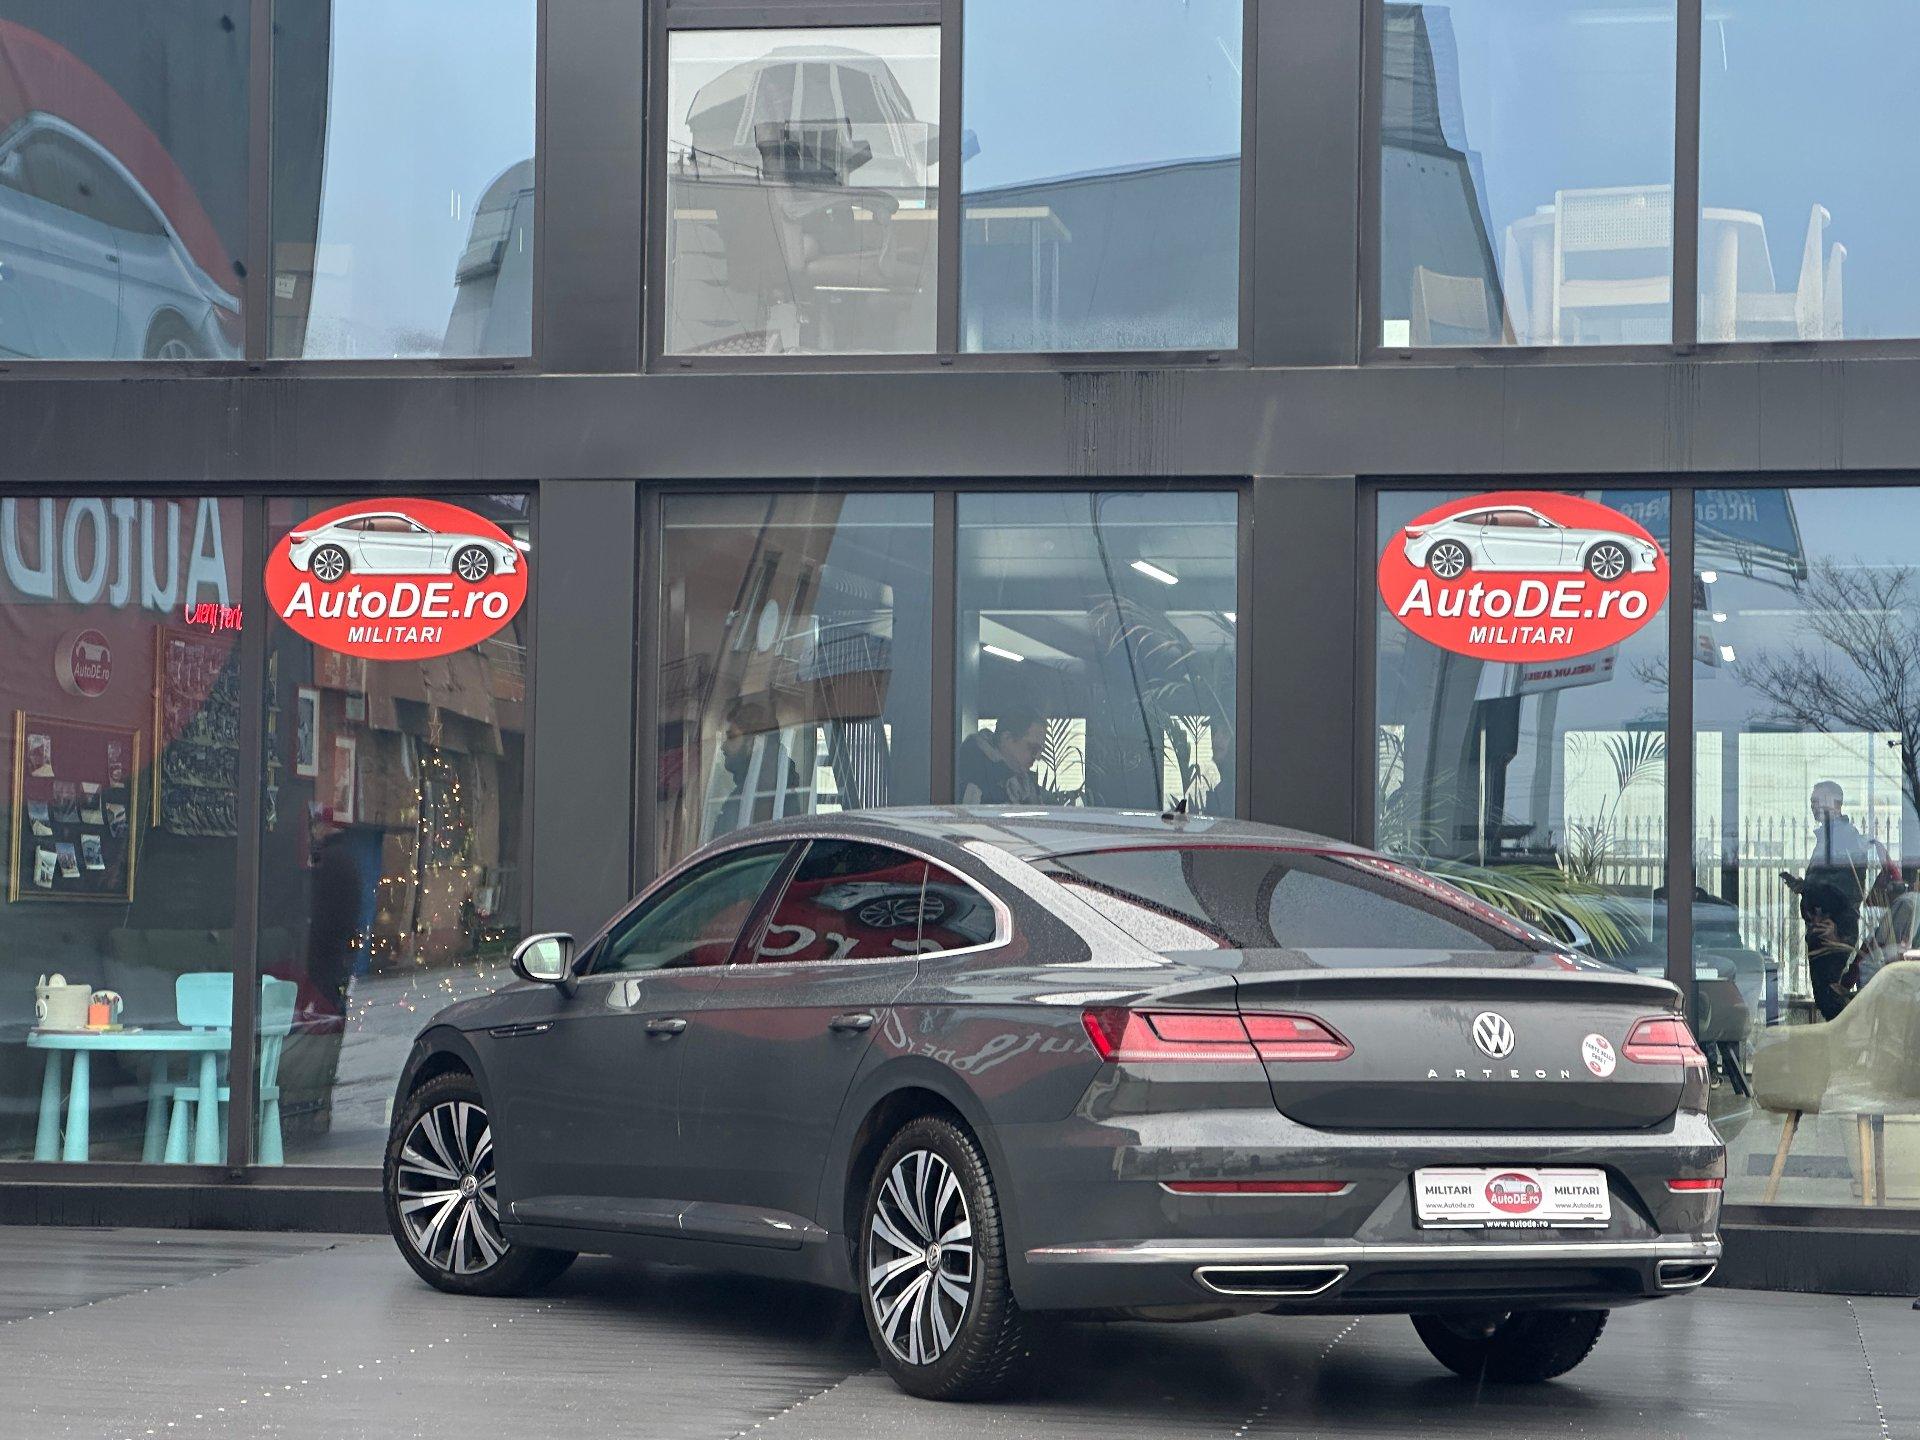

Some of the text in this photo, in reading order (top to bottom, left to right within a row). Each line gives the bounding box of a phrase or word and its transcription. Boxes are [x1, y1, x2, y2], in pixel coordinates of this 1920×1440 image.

[282, 582, 509, 619] AutoDE.ro
[1398, 578, 1649, 619] AutoDE.ro
[347, 626, 443, 643] MILITARI
[1468, 626, 1574, 644] MILITARI
[1427, 1069, 1570, 1080] ARTEON
[1425, 1185, 1472, 1195] MILITARI
[1554, 1185, 1600, 1196] MILITARI
[1491, 1192, 1540, 1205] AutoDE.ro
[1486, 1220, 1549, 1228] www.autode.ro
